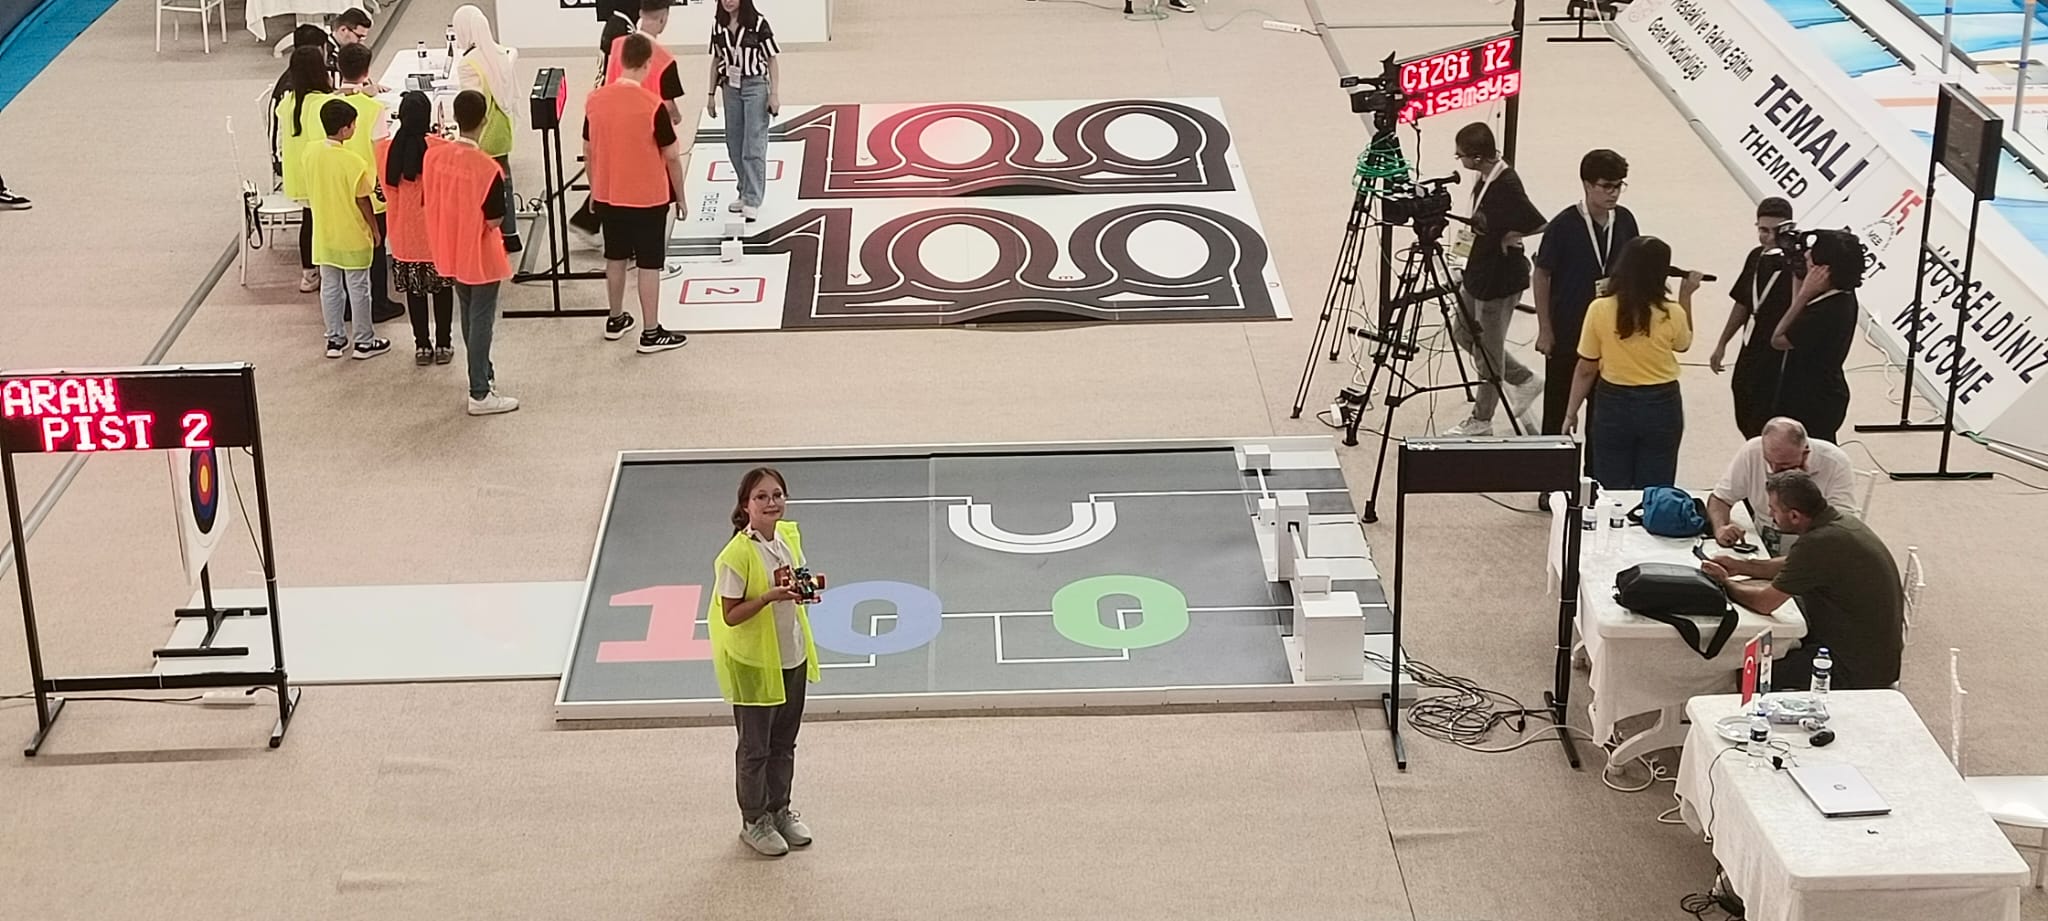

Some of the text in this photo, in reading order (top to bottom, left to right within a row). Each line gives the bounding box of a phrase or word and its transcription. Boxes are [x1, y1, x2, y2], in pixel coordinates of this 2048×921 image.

[1402, 39, 1511, 93] ÇİZGİ İZ
[1648, 17, 1707, 81] Genel Müdürlüğü
[1694, 18, 1710, 35] ve
[1702, 24, 1733, 58] Teknik
[1723, 47, 1753, 81] Eğitim
[1740, 124, 1808, 198] THEMED
[1754, 74, 1869, 191] TEMALI
[0, 377, 117, 417] ARAN
[41, 412, 211, 451] PIST 2
